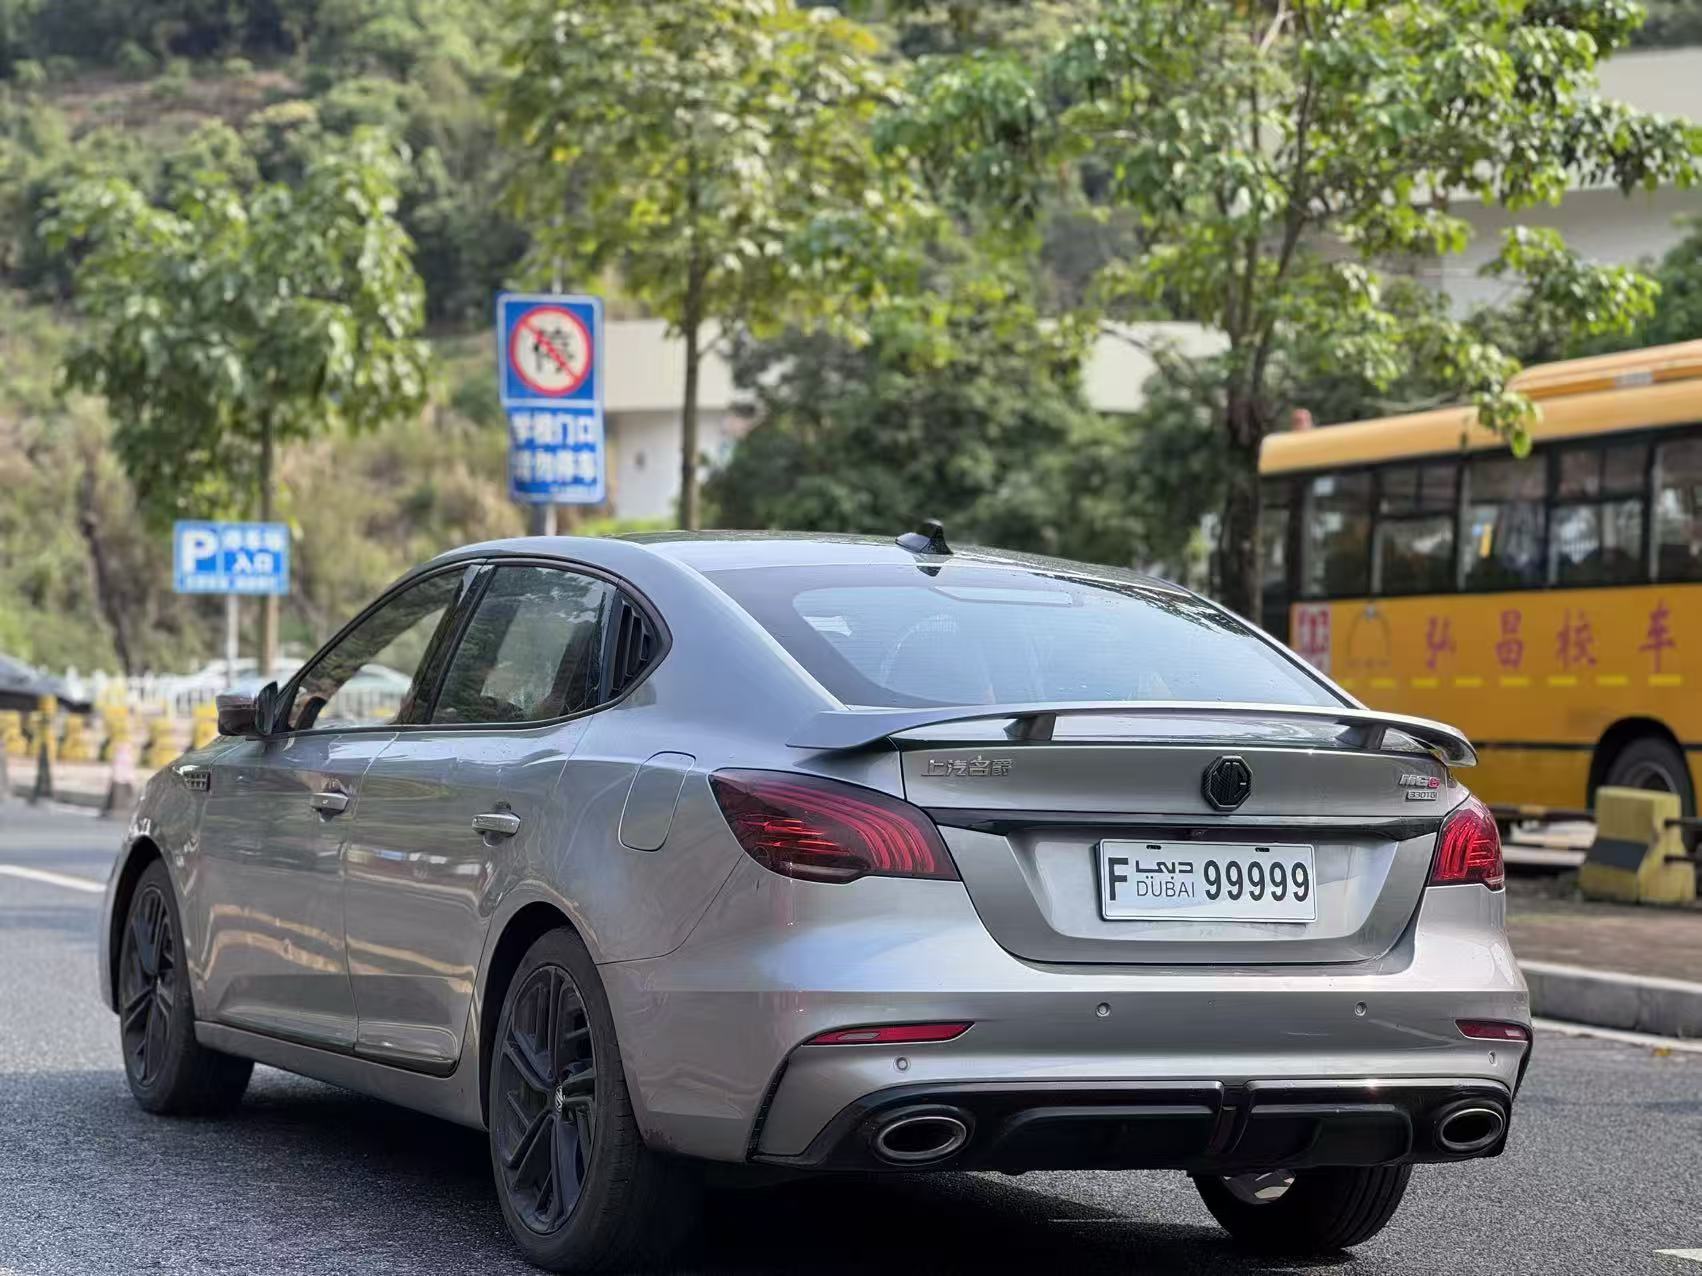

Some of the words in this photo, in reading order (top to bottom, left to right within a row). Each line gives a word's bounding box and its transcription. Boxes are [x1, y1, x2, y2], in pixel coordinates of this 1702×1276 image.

[182, 529, 218, 574] P
[921, 755, 1015, 777] 上汽名爵
[1107, 857, 1129, 902] F
[1136, 880, 1195, 898] DUBAI
[1203, 859, 1310, 902] 99999
